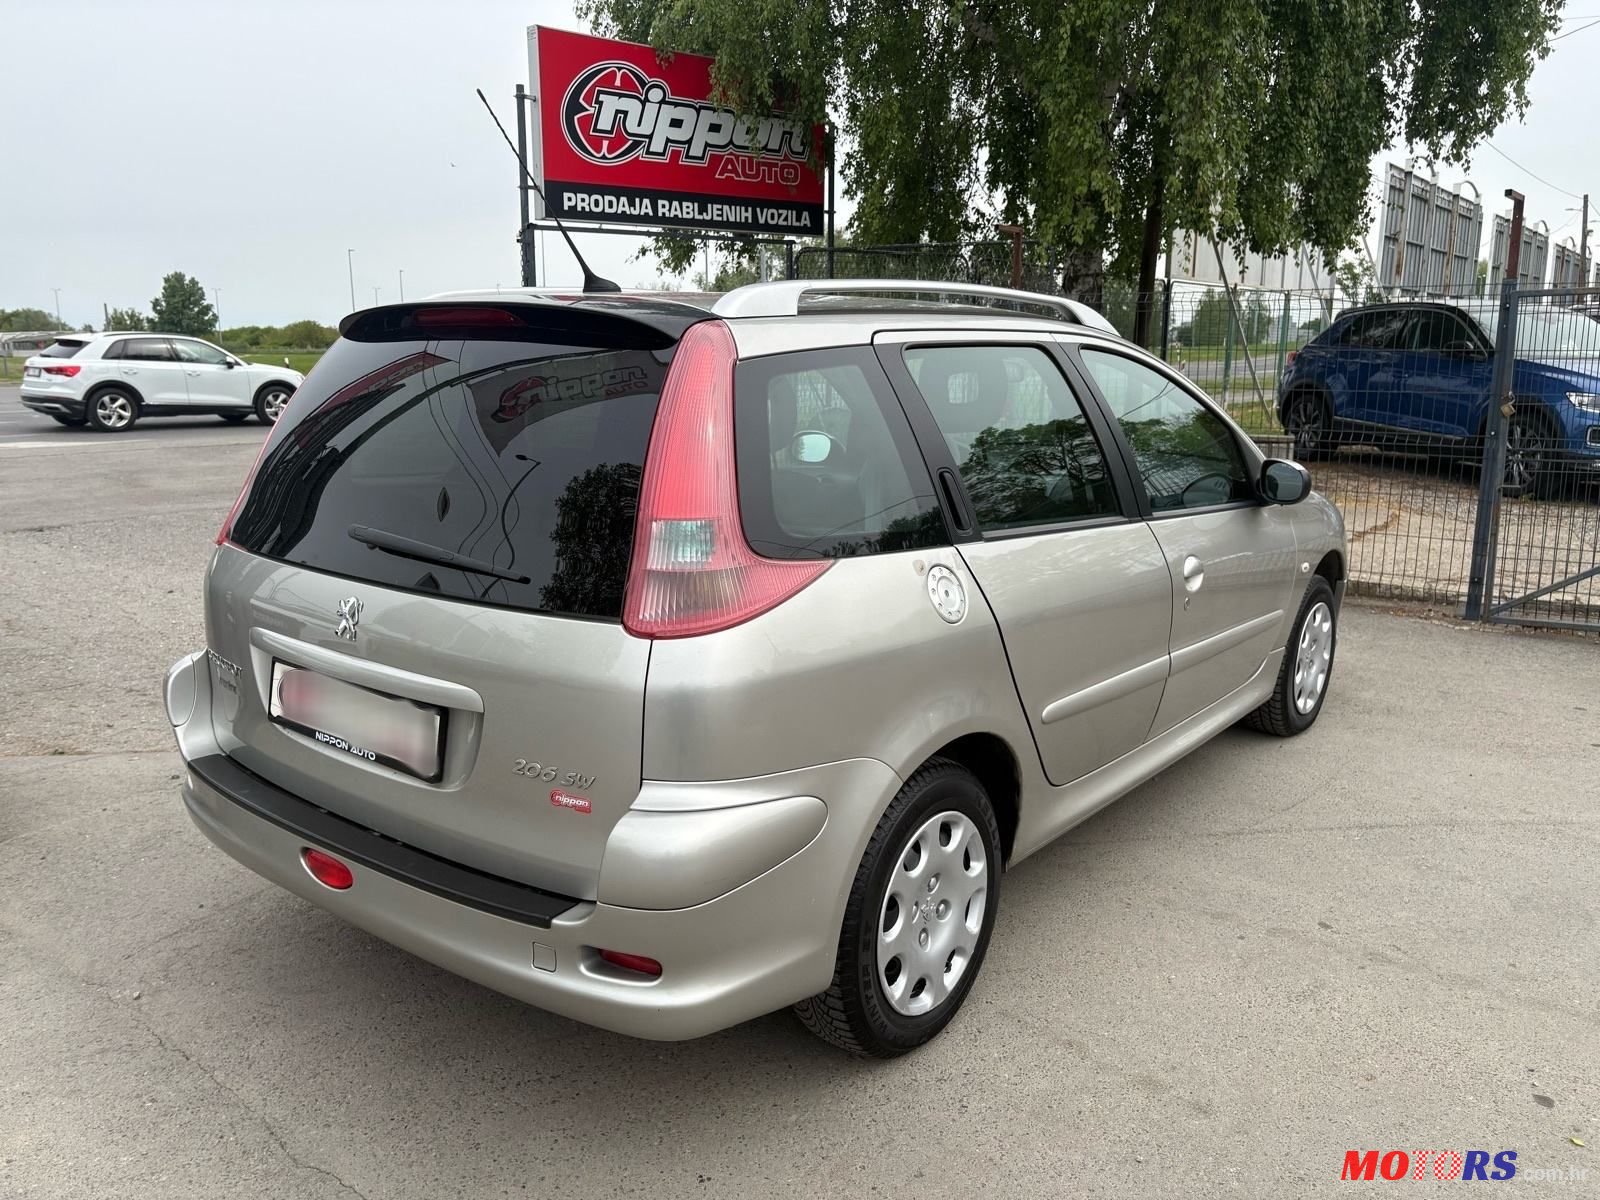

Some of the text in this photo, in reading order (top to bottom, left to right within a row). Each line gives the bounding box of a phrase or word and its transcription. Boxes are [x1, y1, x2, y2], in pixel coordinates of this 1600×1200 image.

[594, 85, 806, 160] nippon
[715, 155, 801, 185] AUTO
[562, 191, 811, 228] PRODAJA RABLJENIH VOZILA
[315, 731, 376, 761] NIPPON AUTO
[512, 758, 597, 790] 206 SW
